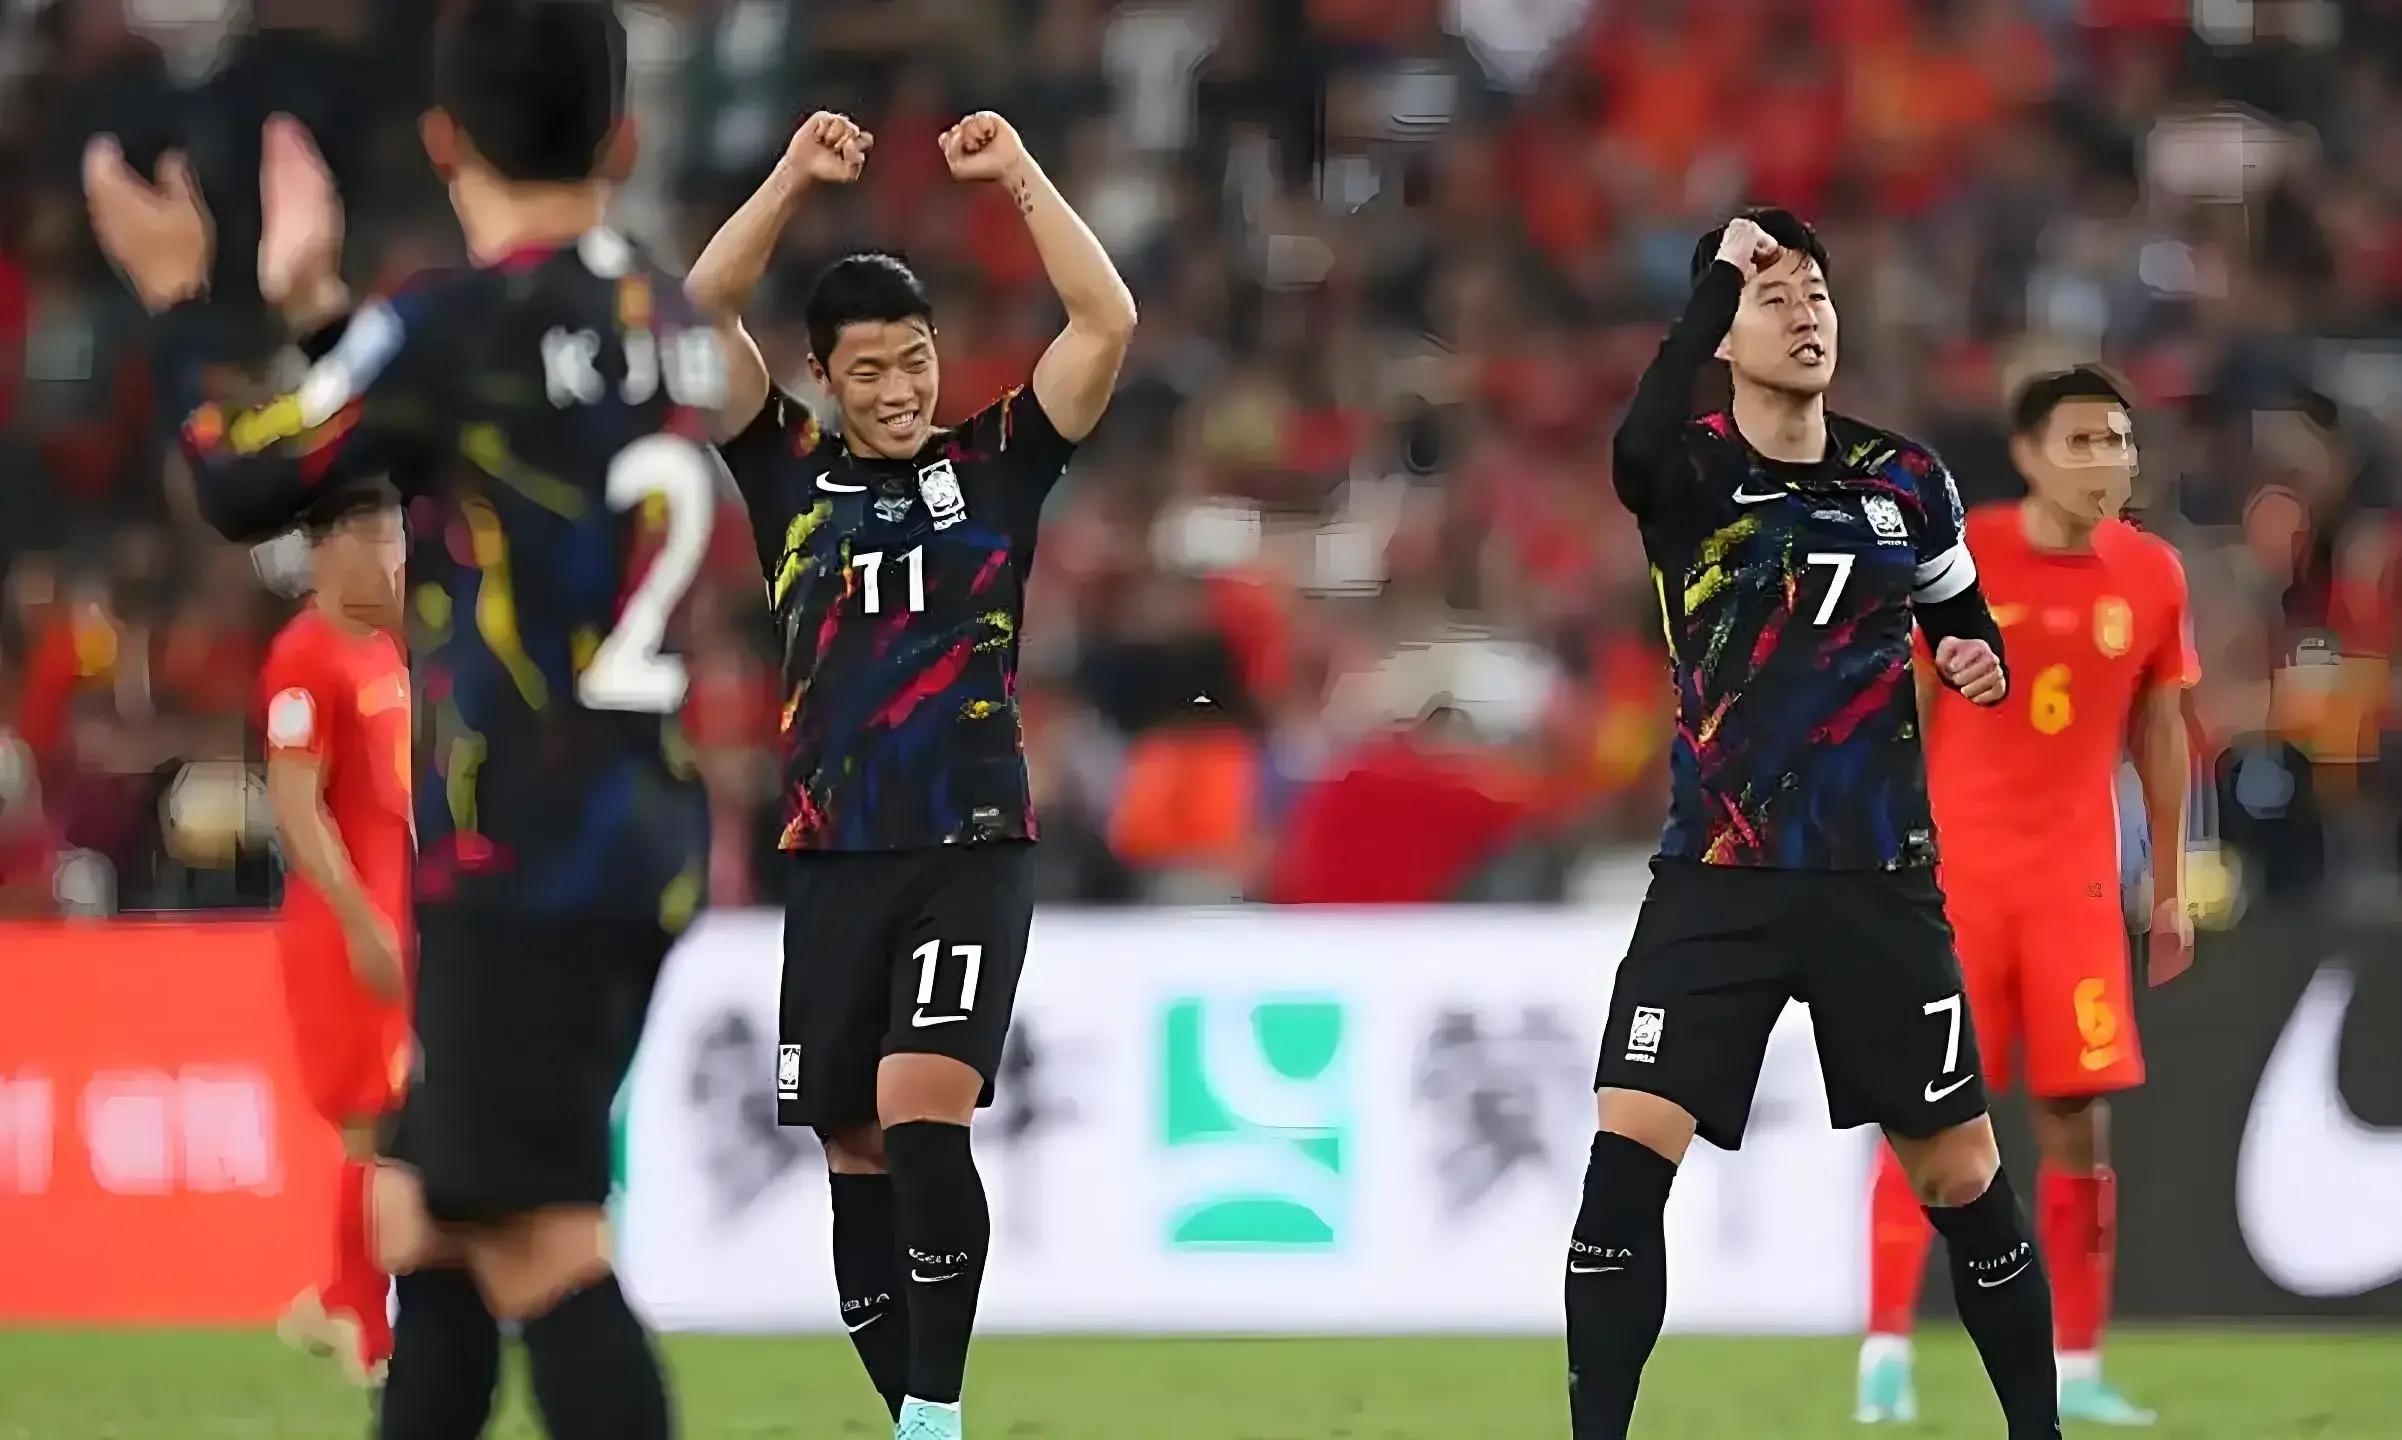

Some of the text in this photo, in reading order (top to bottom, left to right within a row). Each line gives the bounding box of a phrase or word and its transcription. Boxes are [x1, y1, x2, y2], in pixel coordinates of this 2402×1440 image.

[577, 433, 715, 713] 2
[852, 544, 925, 614] 11
[1807, 552, 1856, 625] 7
[2031, 663, 2074, 735] 6
[912, 939, 983, 1012] 11
[2073, 977, 2116, 1047] 6
[1922, 993, 1962, 1074] 7
